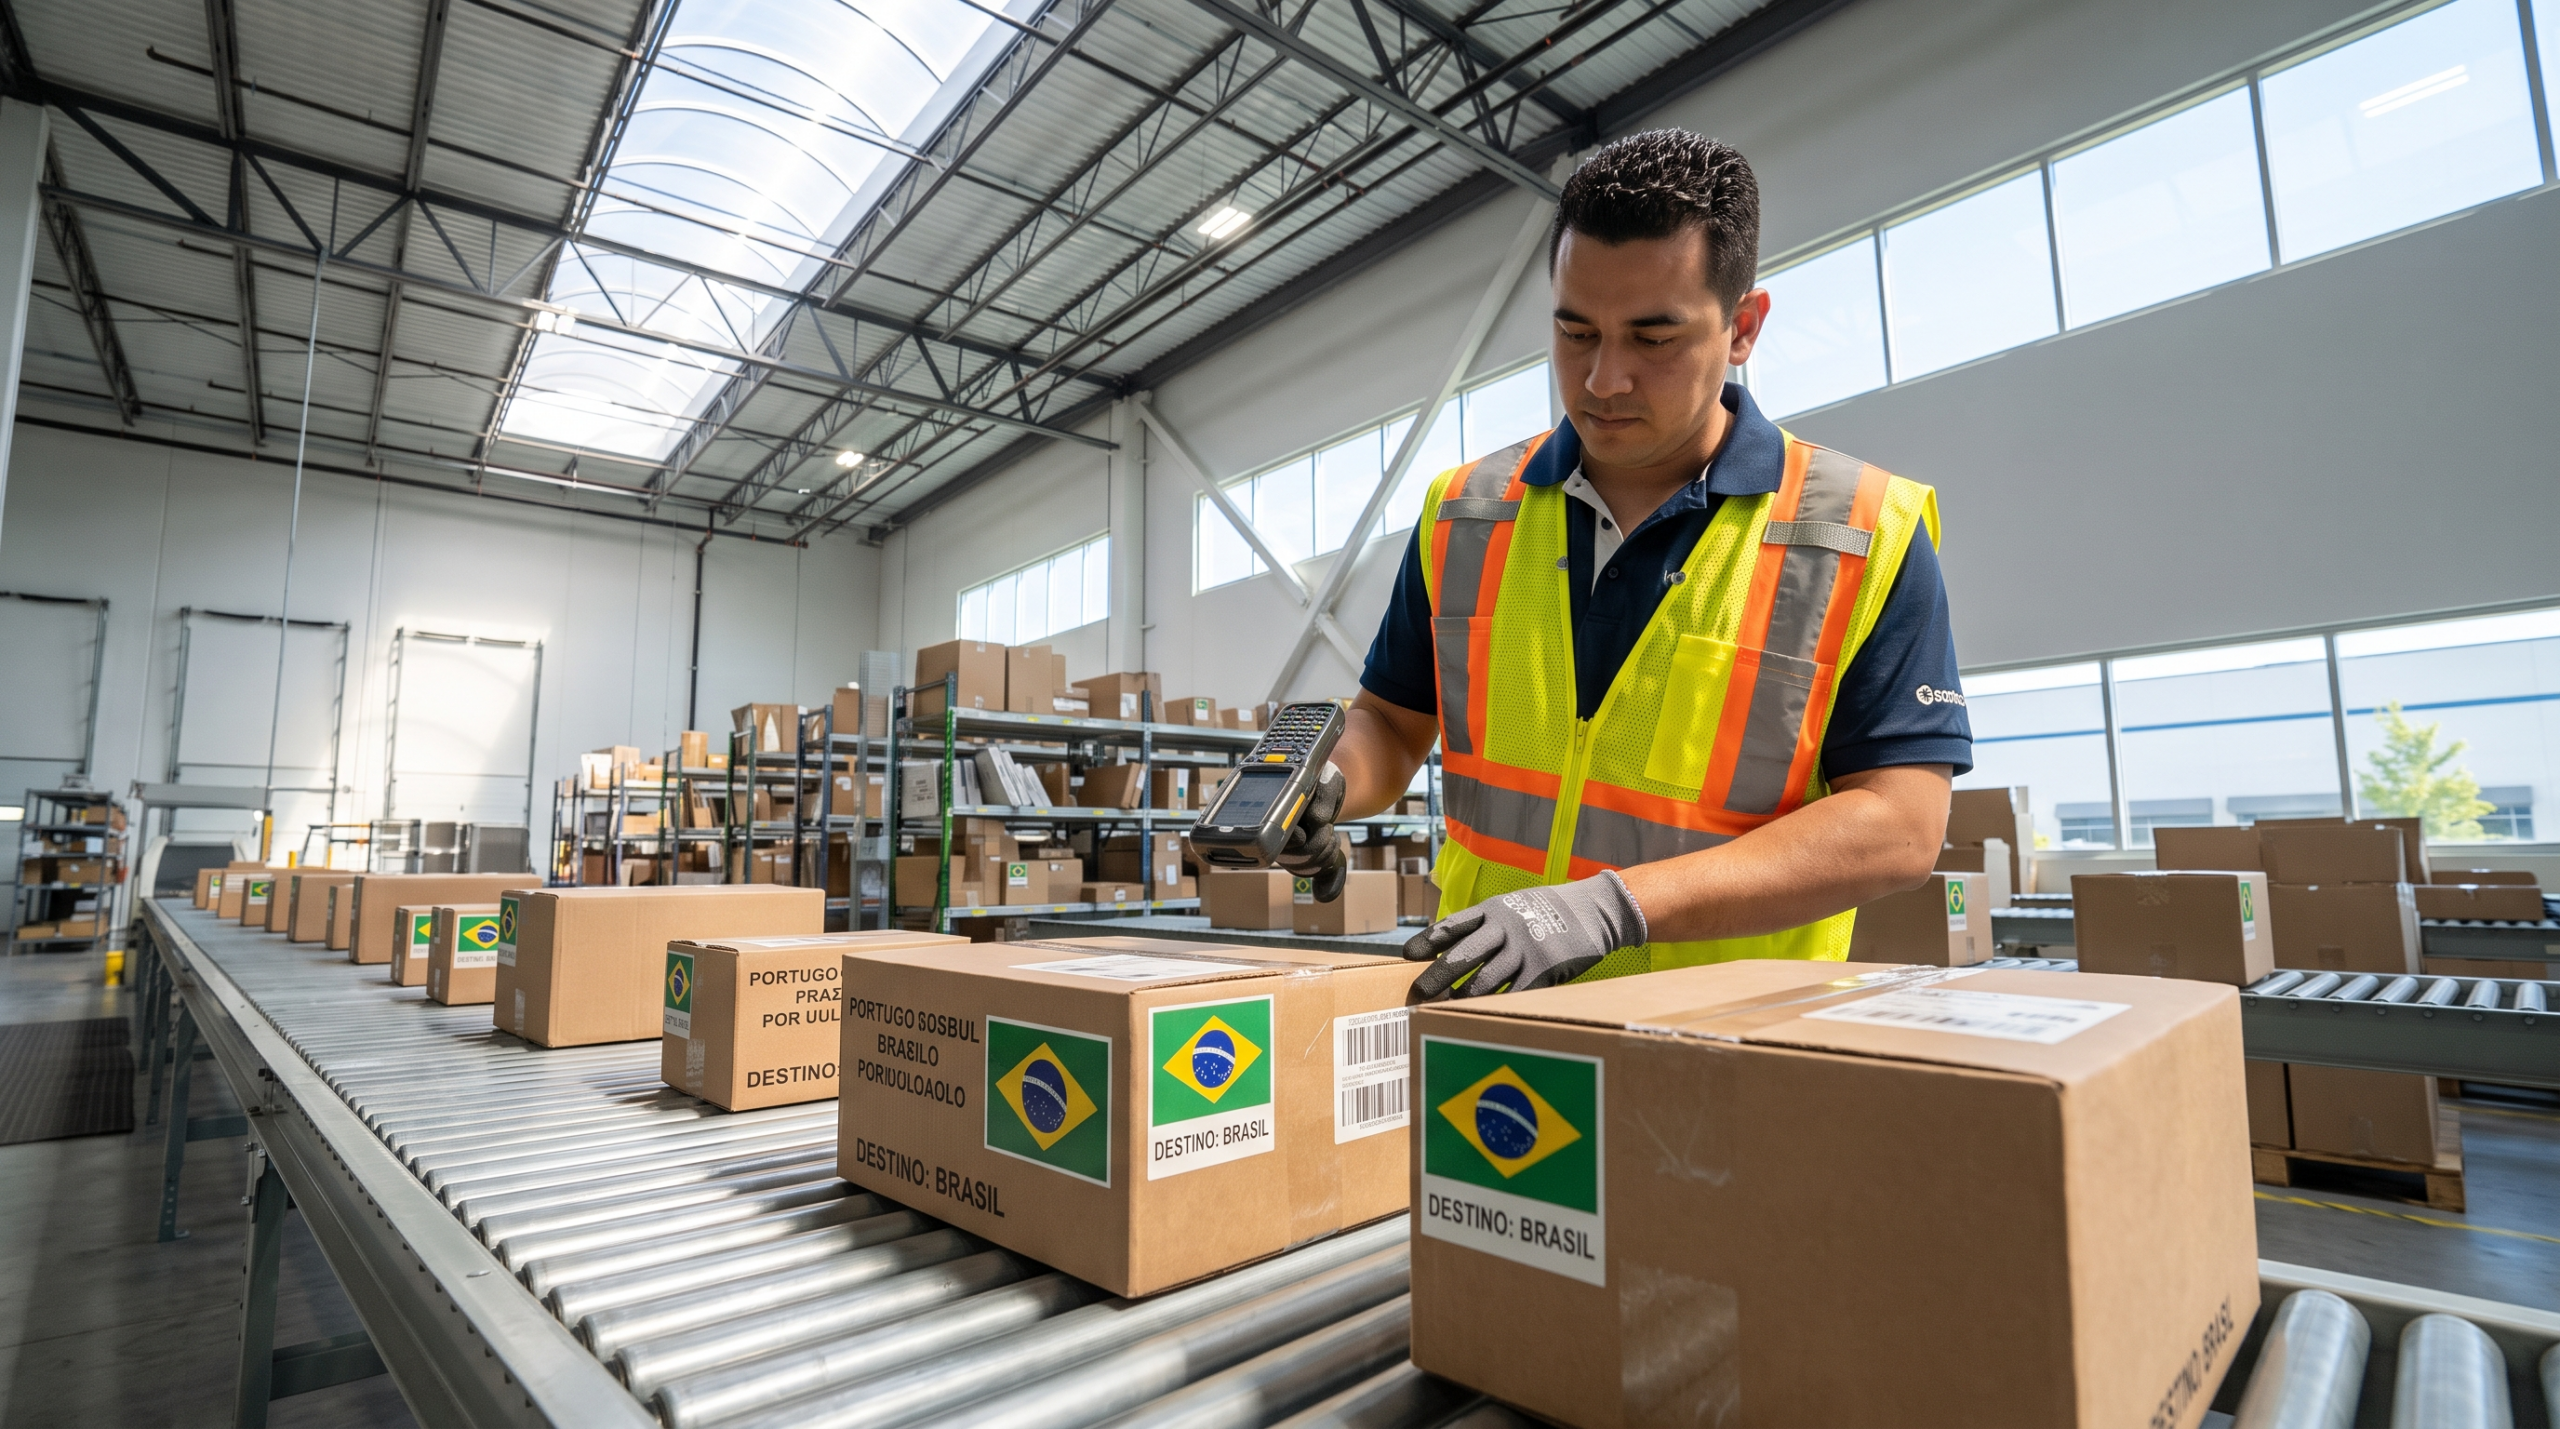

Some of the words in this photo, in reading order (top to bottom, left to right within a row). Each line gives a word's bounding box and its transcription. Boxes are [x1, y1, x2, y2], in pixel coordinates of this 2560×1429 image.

[750, 967, 838, 986] PORTUGO
[762, 1011, 800, 1028] POR
[850, 996, 915, 1029] PORTUGO
[1155, 1130, 1219, 1161] DESTINO:
[1223, 1119, 1269, 1146] BRASIL
[856, 1137, 930, 1189] DESTINO:
[935, 1166, 1005, 1218] BRASIL
[1429, 1193, 1514, 1239] DESTINO:
[1520, 1216, 1596, 1261] BRASIL
